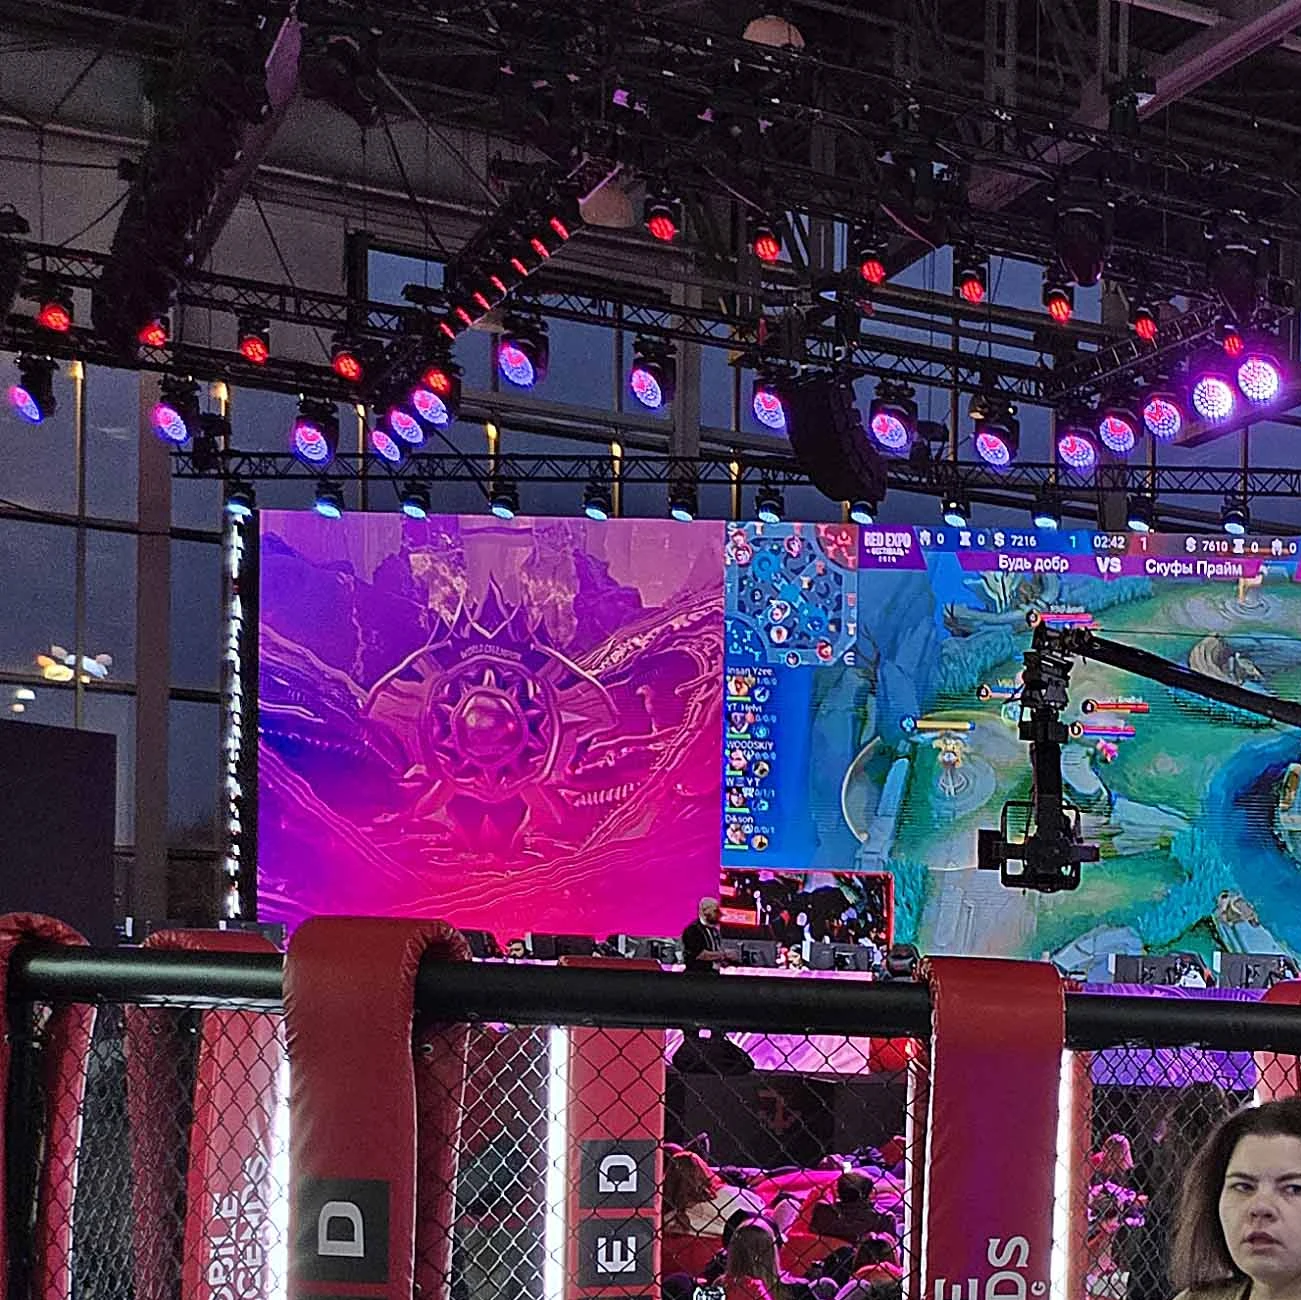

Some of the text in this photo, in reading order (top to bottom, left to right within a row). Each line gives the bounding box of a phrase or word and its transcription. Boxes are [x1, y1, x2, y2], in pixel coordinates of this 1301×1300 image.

[1011, 537, 1037, 547] 7216
[1093, 536, 1126, 549] 02:42
[1202, 540, 1228, 552] 7610
[999, 555, 1070, 573] Будь добр
[1096, 557, 1122, 573] VS
[1146, 560, 1243, 578] Скуфы Прайм
[597, 1154, 637, 1273] ED
